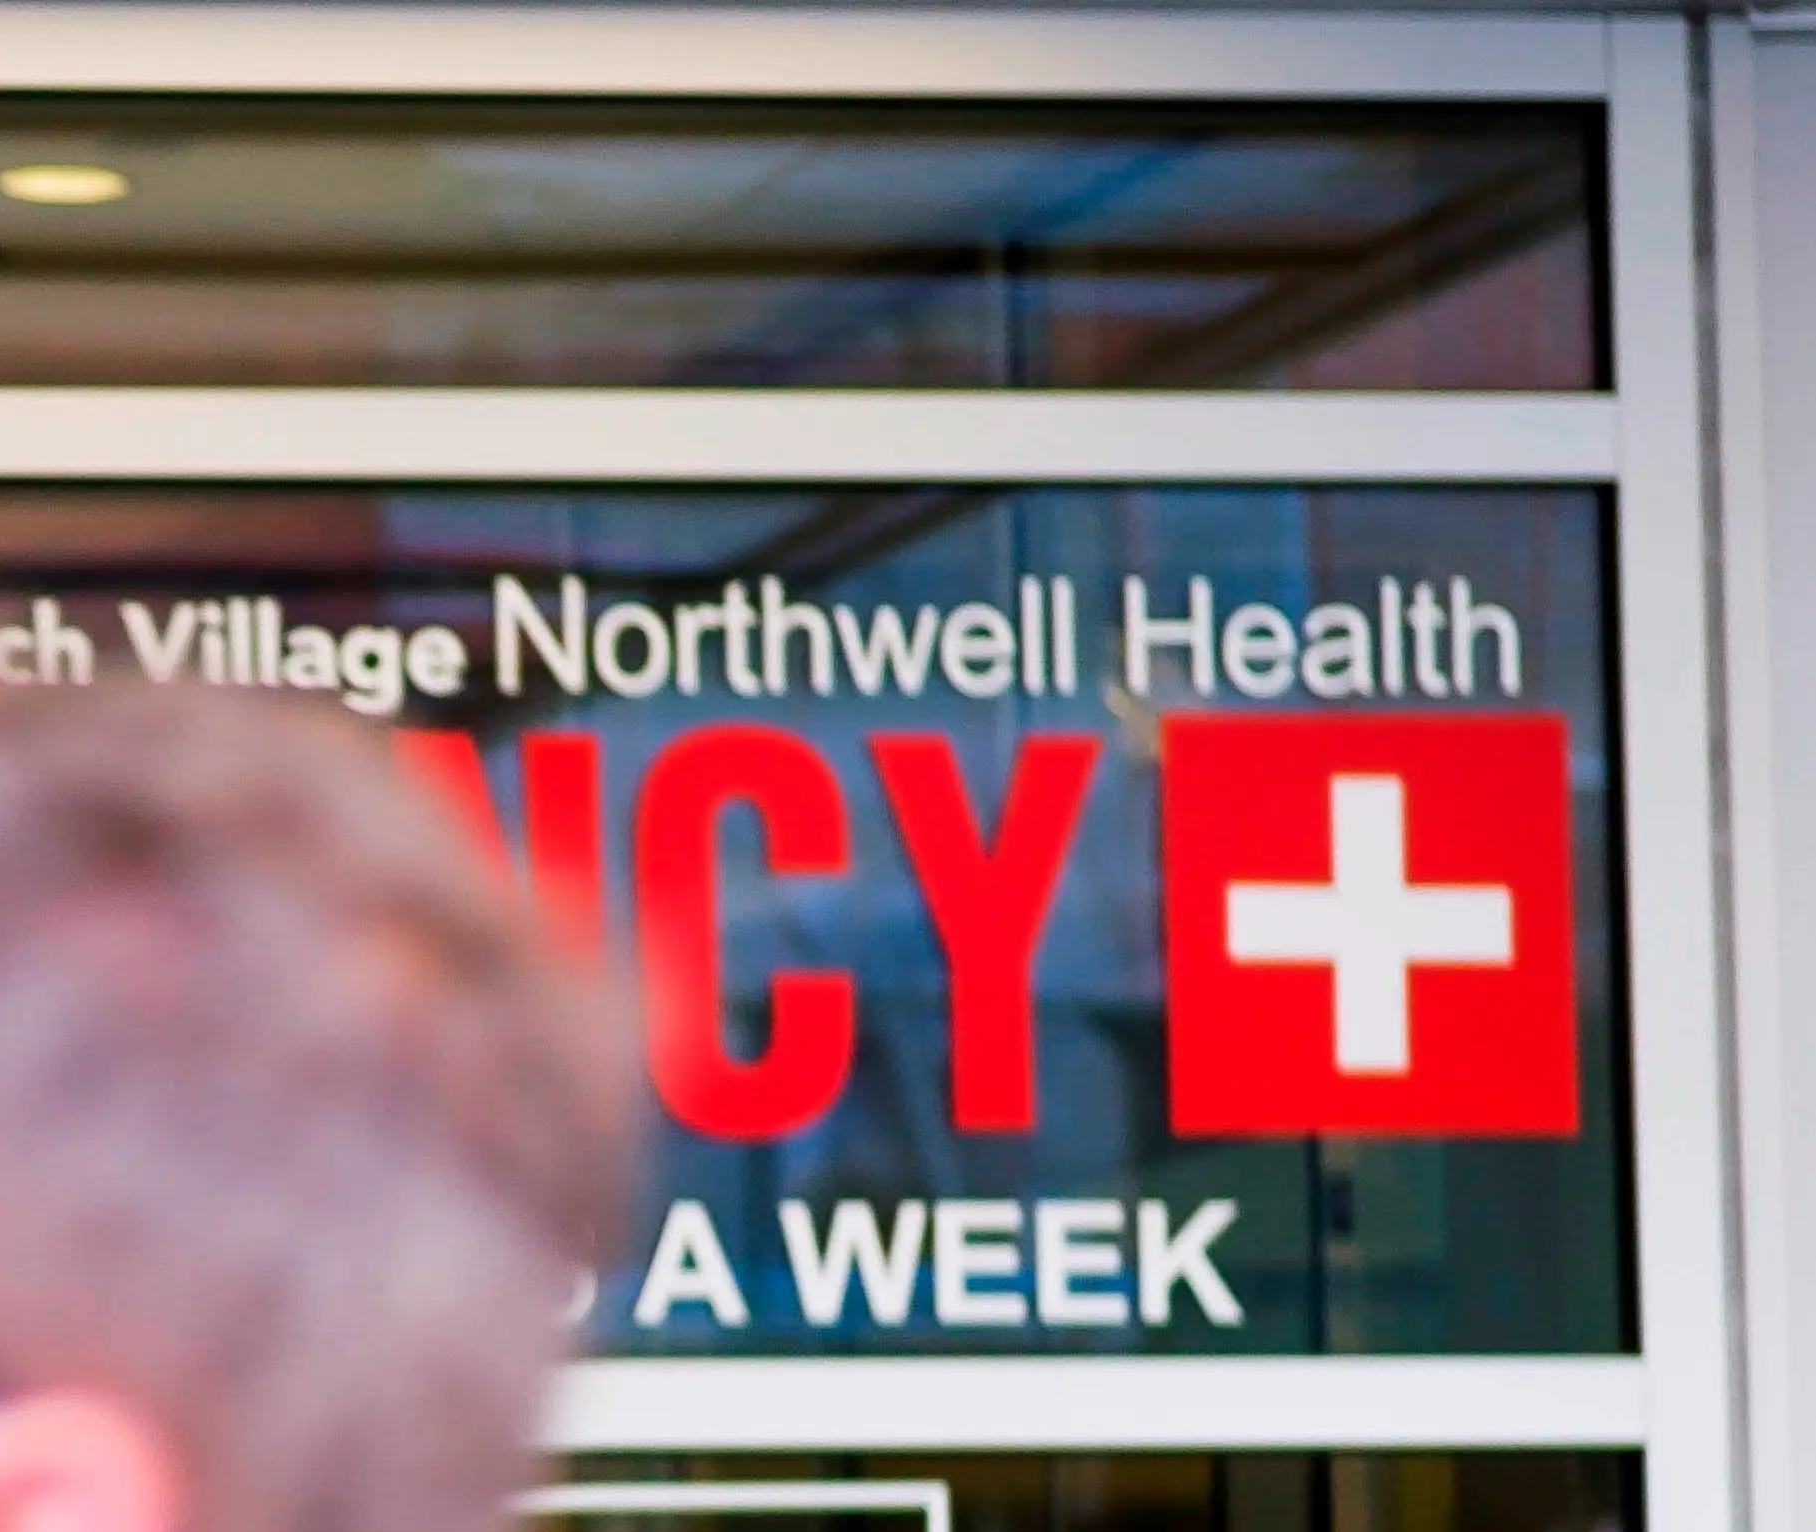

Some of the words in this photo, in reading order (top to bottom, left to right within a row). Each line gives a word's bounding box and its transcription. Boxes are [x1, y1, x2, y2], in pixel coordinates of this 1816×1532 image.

[119, 598, 467, 714] Village
[493, 574, 1078, 698] Northwell
[1123, 576, 1524, 698] Health
[632, 1199, 750, 1328] A
[778, 1199, 1243, 1326] WEEK
